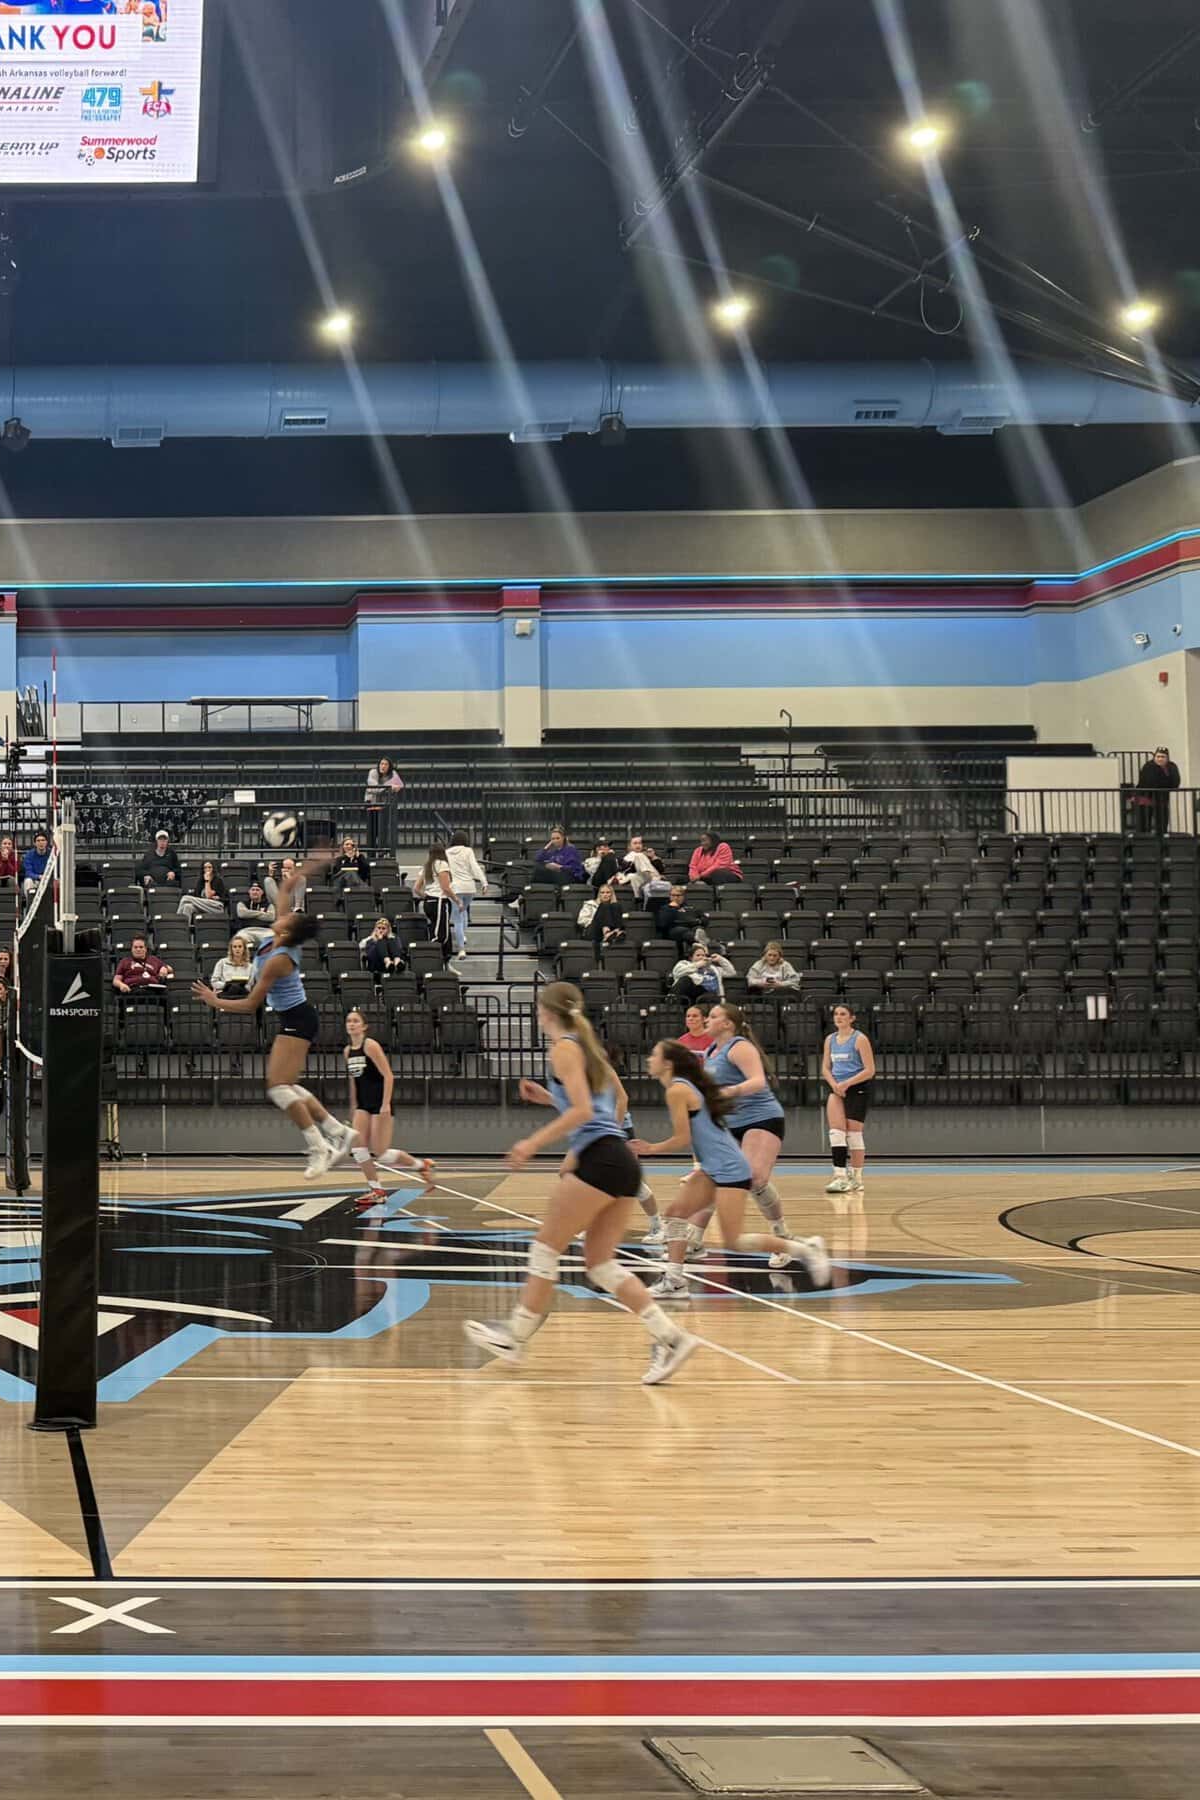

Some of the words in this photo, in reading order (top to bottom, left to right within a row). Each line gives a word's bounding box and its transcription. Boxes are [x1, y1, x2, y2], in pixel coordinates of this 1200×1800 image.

[52, 25, 116, 50] YOU
[9, 69, 48, 77] Arkansas
[50, 69, 89, 79] volleyball
[90, 69, 127, 77] forward!
[81, 87, 121, 107] 479
[39, 142, 60, 151] UP
[80, 135, 158, 146] Summerwood
[106, 146, 157, 163] Sports
